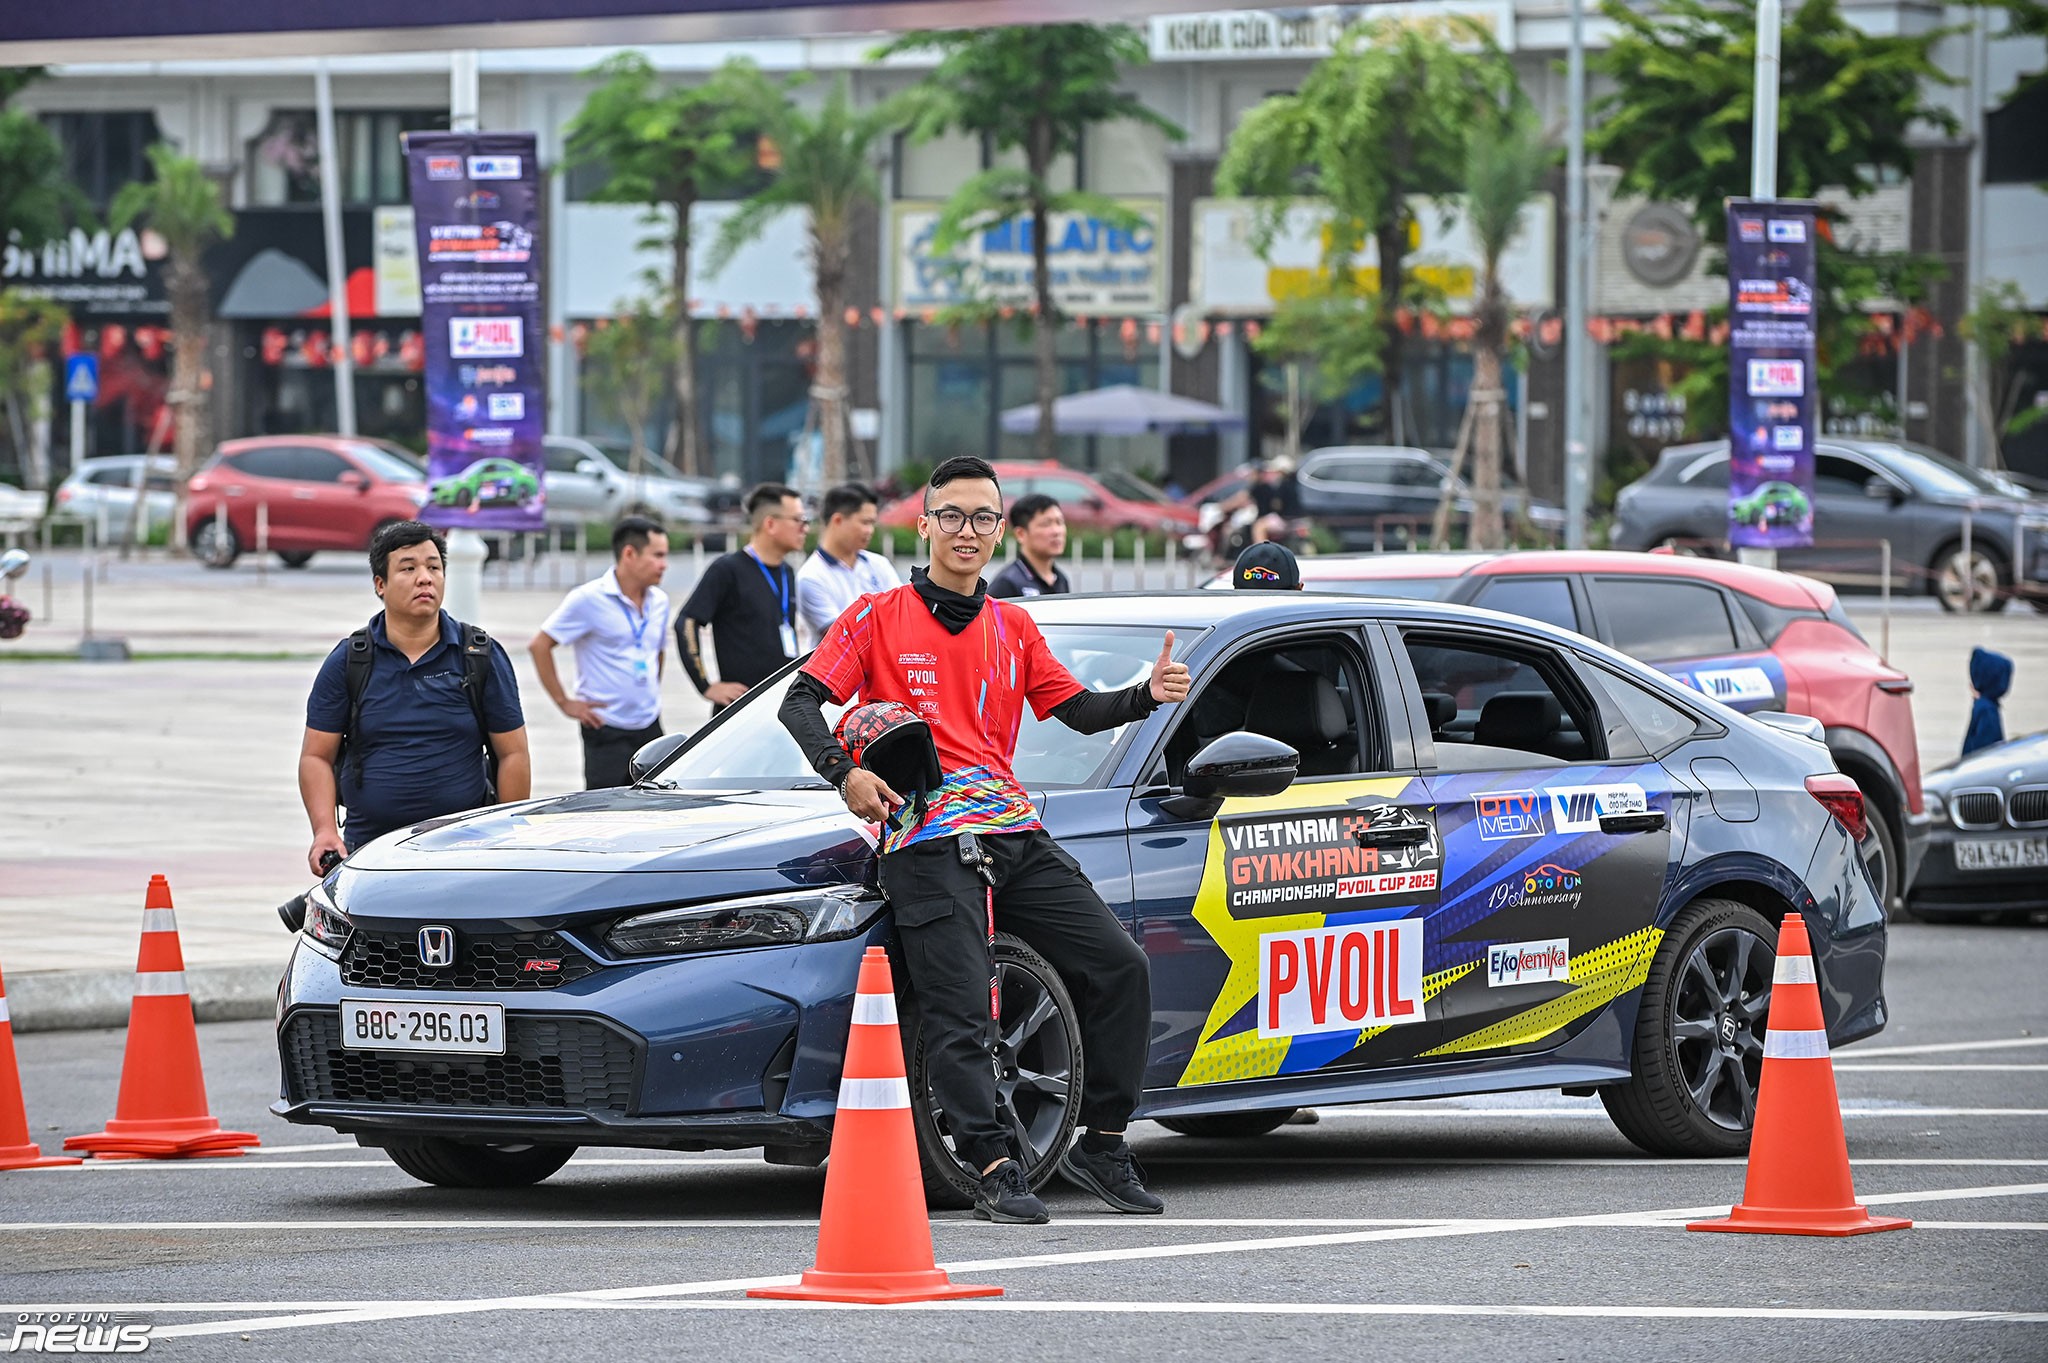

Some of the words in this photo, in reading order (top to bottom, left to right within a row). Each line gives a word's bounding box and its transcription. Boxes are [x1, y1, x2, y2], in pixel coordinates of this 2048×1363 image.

[907, 669, 938, 684] PVOIL
[1227, 817, 1338, 851] VIETNAM
[1483, 813, 1540, 834] MEDIA
[1232, 847, 1379, 885] GYMKHANA
[1233, 882, 1336, 907] CHAMPIONSHIP
[1338, 877, 1376, 896] PVOIL
[1379, 875, 1406, 892] CUP
[1409, 873, 1436, 889] 2025
[1508, 886, 1583, 910] Anniversary
[523, 958, 561, 972] RS
[1268, 928, 1415, 1030] PVOIL
[355, 1009, 490, 1044] 88C-296.03
